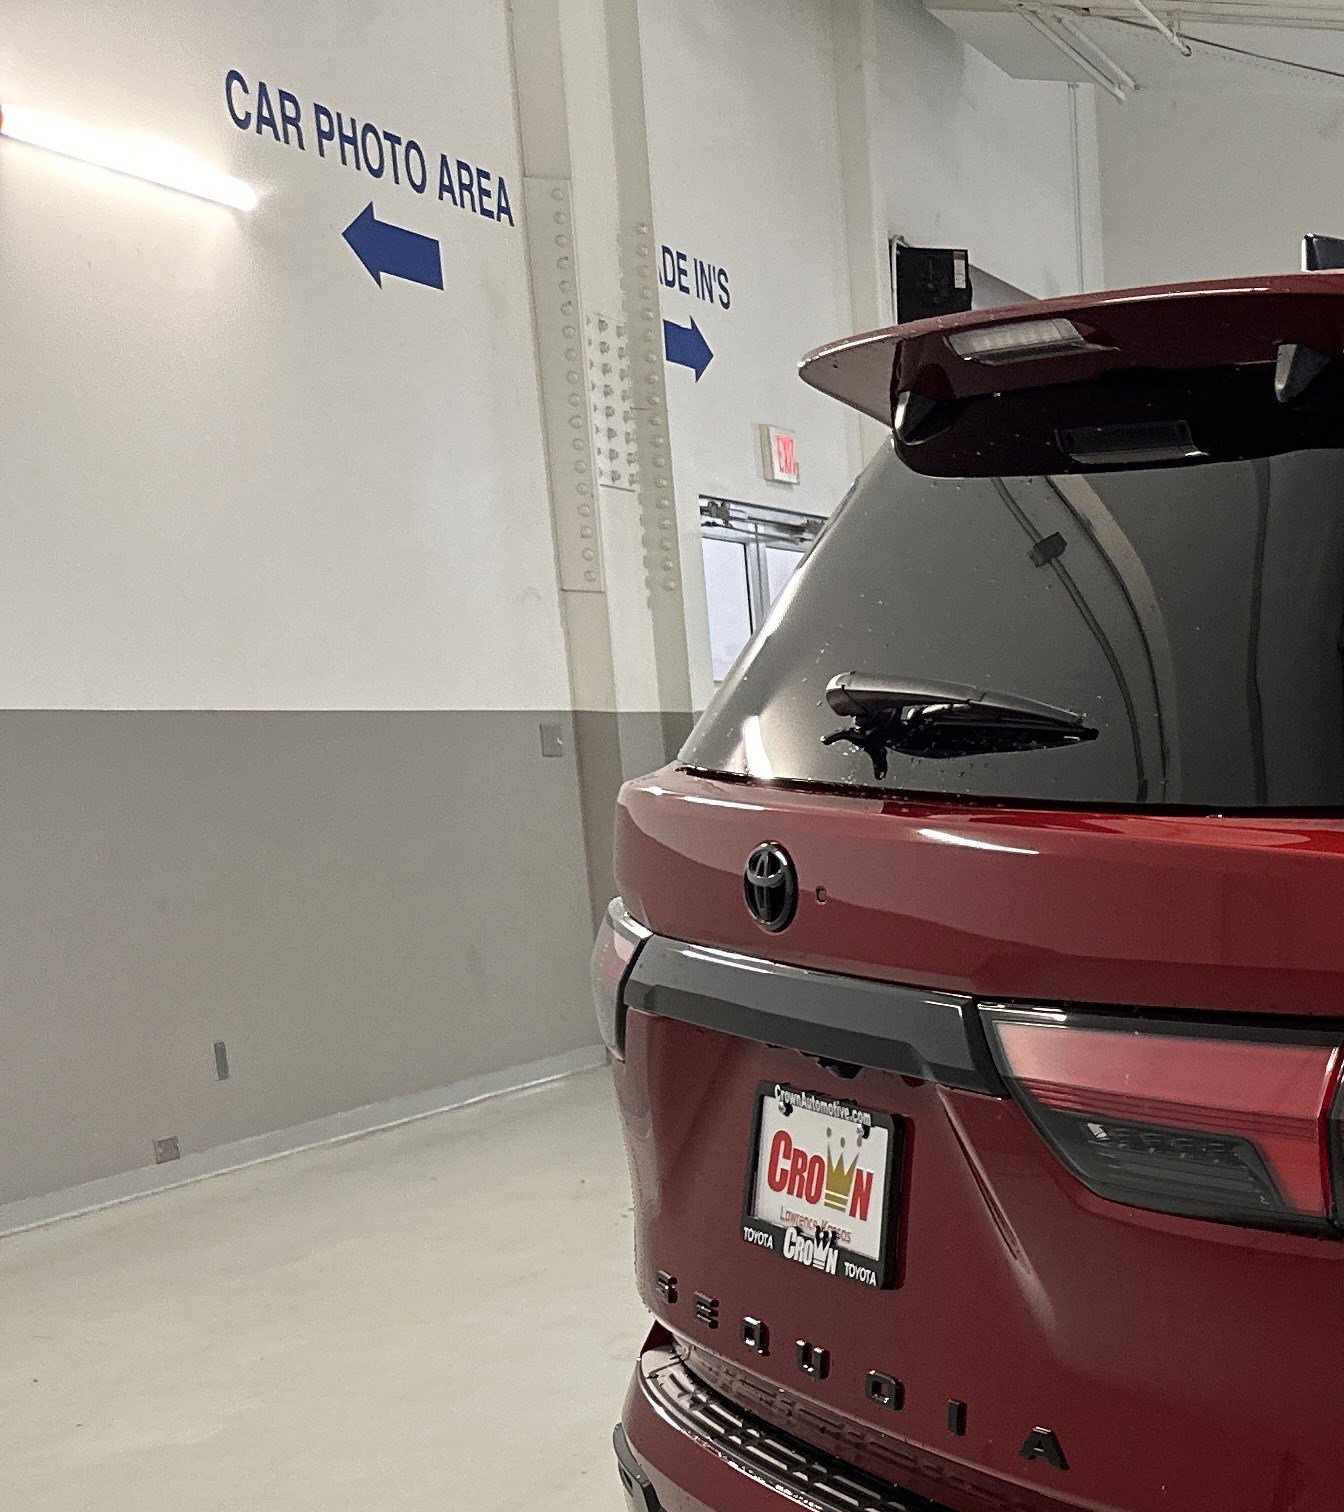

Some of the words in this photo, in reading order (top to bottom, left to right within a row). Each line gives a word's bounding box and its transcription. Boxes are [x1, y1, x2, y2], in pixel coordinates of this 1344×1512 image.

[224, 69, 306, 151] CAR
[313, 102, 428, 194] PHOTO
[438, 153, 515, 227] AREA
[658, 244, 690, 295] DE
[693, 257, 731, 310] IN'S
[774, 1084, 871, 1126] CrownAutomotive.com
[743, 1226, 774, 1250] TOYOTA
[844, 1261, 877, 1286] TOYOTA
[657, 1270, 1070, 1470] SEQUOIA
